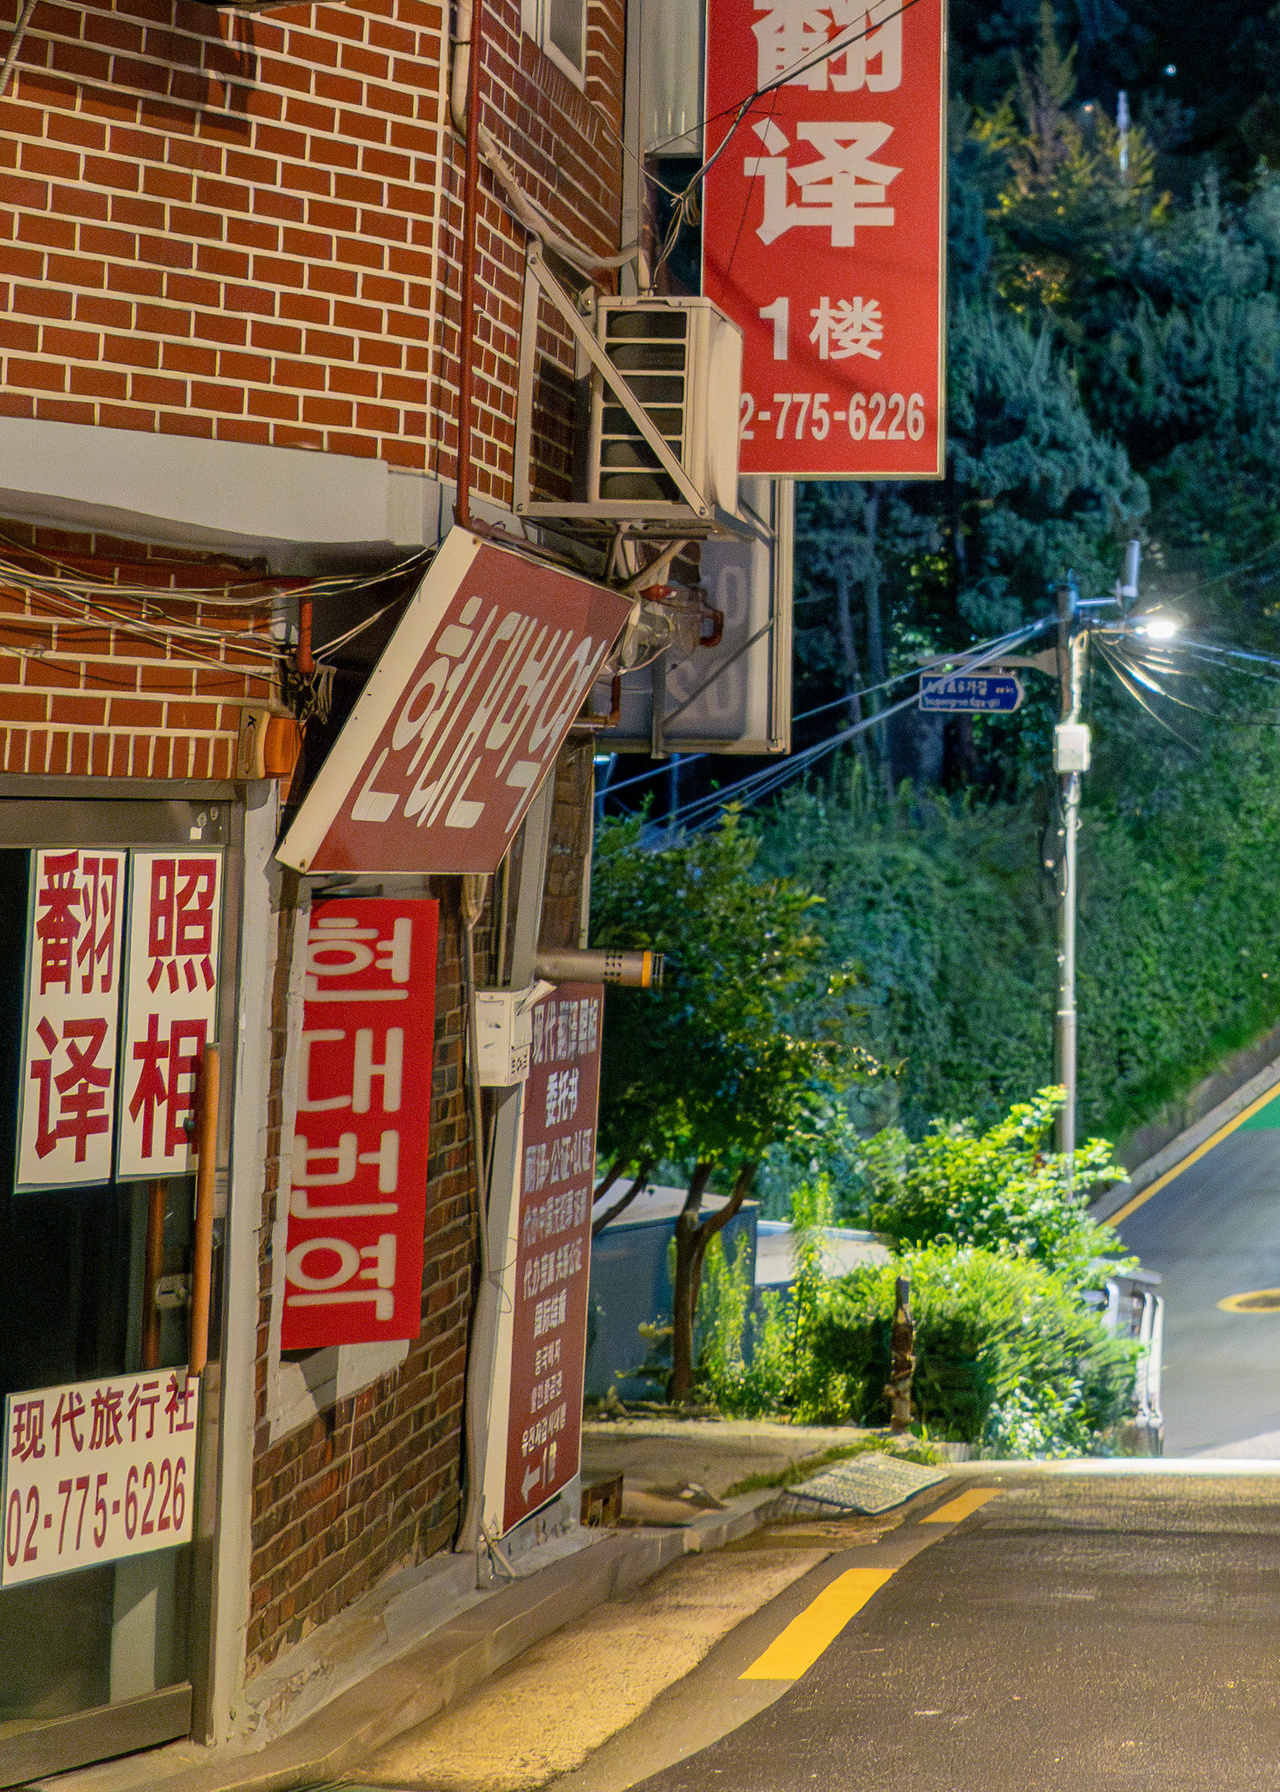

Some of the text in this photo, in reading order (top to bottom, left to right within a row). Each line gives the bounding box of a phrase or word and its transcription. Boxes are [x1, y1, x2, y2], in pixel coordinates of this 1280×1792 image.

[759, 296, 884, 361] 1楼
[350, 595, 607, 834] 현대번역
[30, 849, 120, 1163] 翻译
[128, 858, 218, 1159] 照相
[285, 916, 413, 1322] 현대번역
[546, 1068, 580, 1128] 委托书
[11, 1373, 196, 1464] 现代旅行社
[6, 1456, 187, 1567] 02-775-6226
